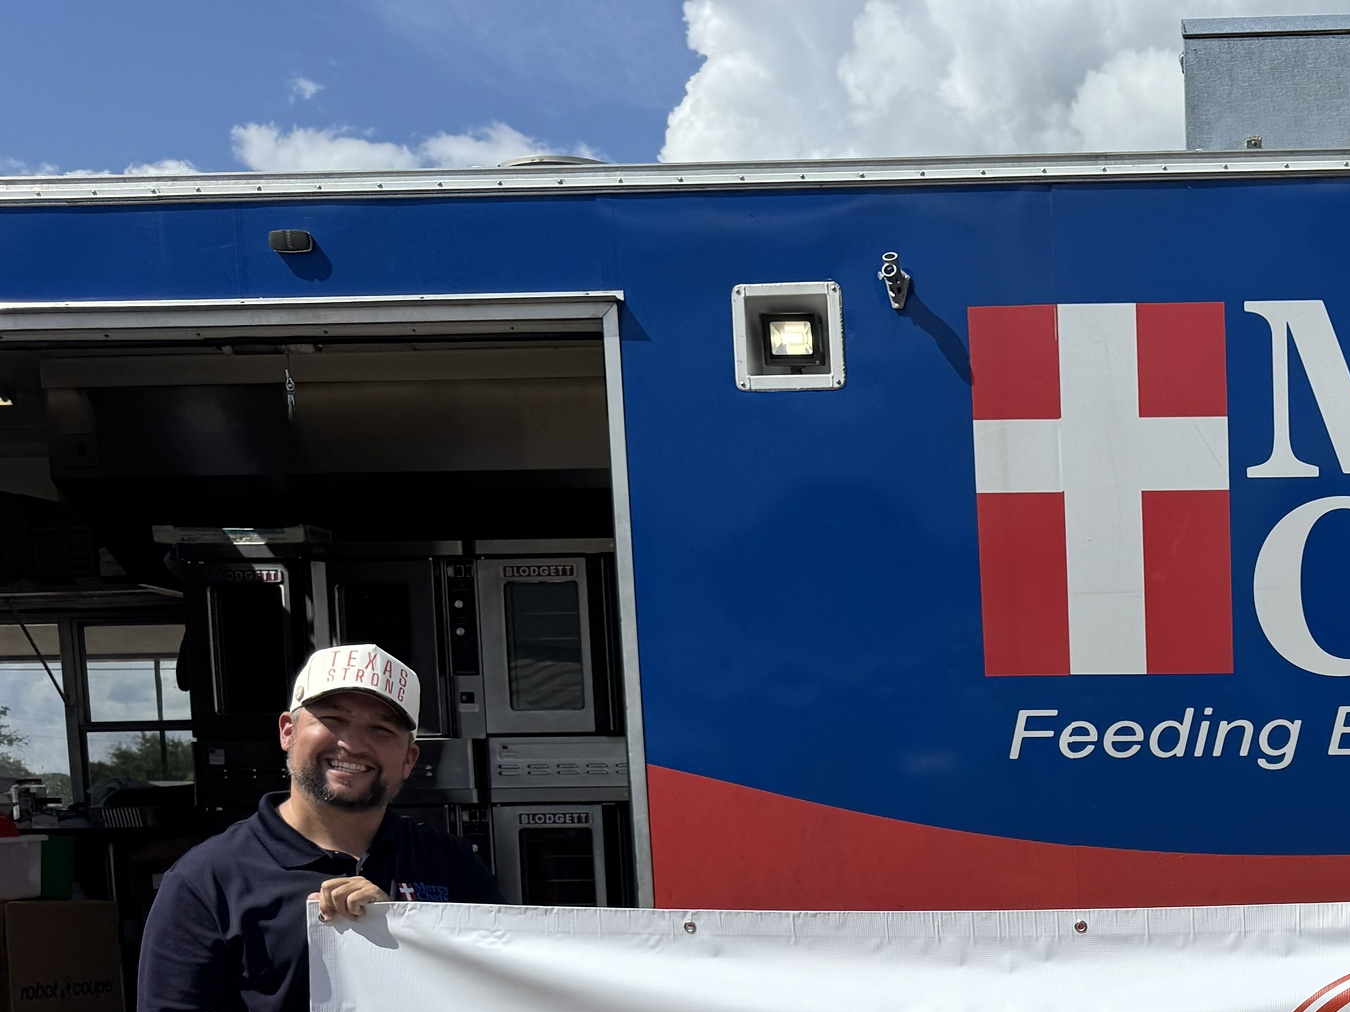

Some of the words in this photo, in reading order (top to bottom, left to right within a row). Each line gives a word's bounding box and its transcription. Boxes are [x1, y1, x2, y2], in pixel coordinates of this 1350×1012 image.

[504, 565, 572, 577] BLODGETT
[331, 650, 408, 688] TEXAS
[326, 668, 405, 703] STRONG
[1008, 707, 1302, 771] Feeding
[520, 813, 587, 824] BLODGETT
[412, 882, 449, 896] Mercy
[20, 981, 58, 1001] robot
[73, 979, 113, 998] coupe
